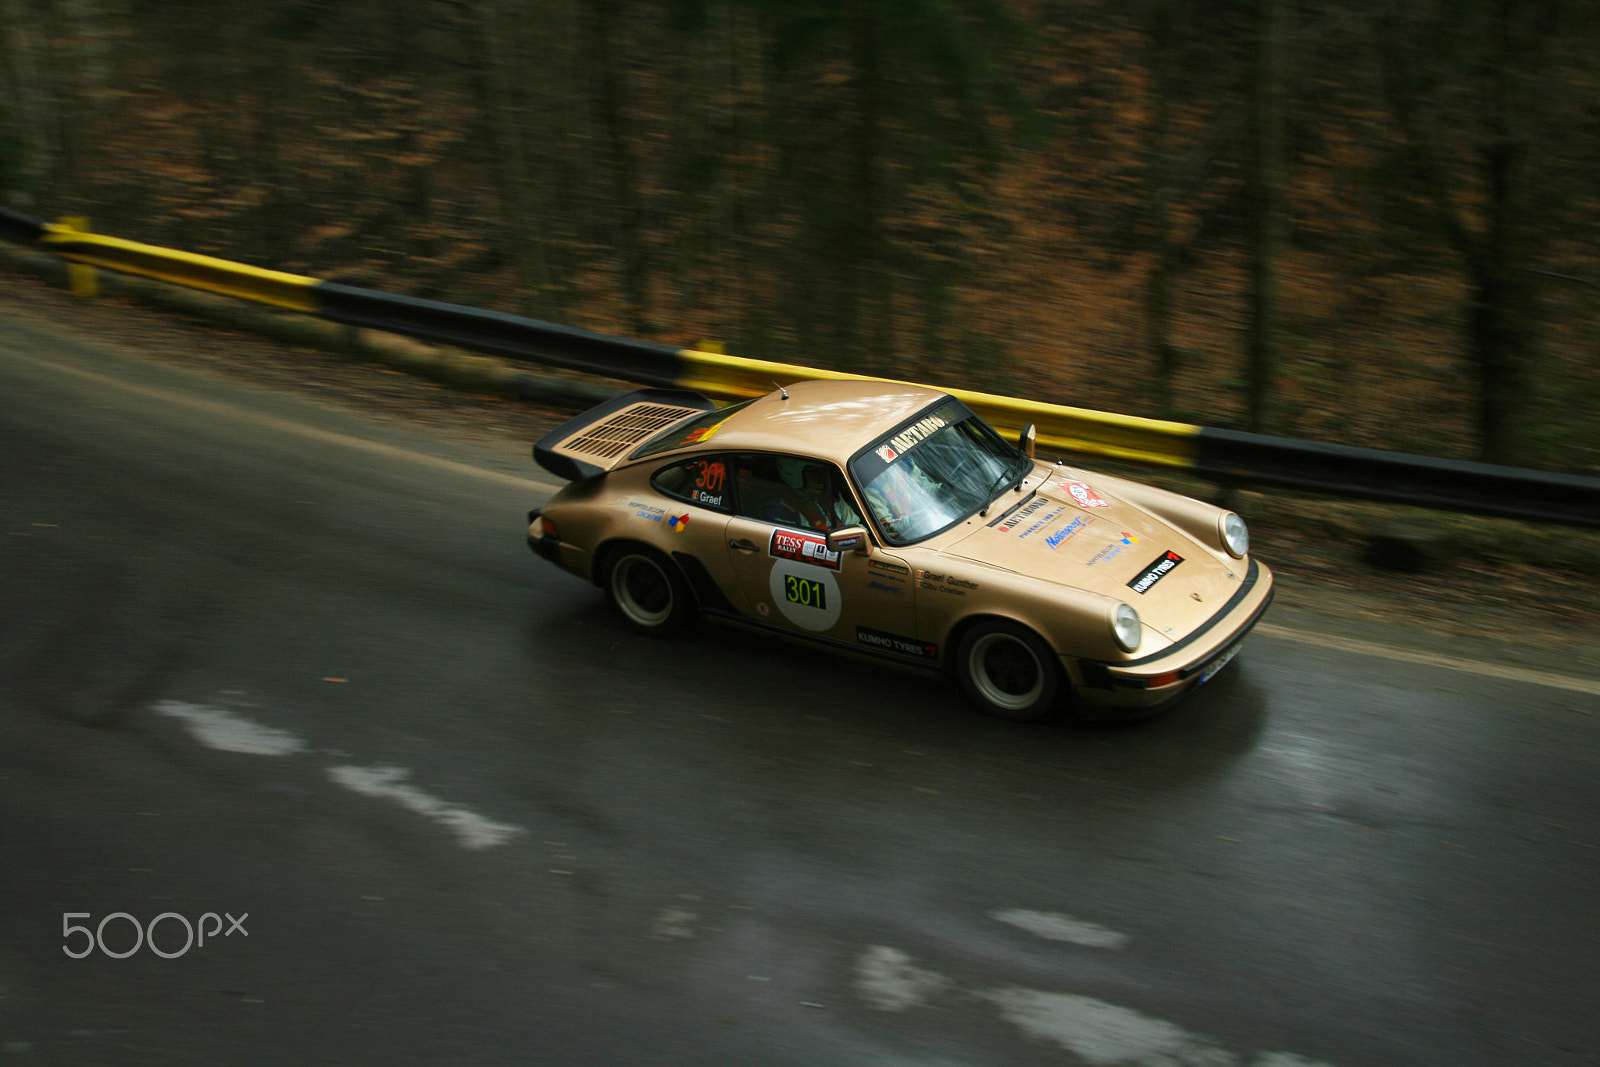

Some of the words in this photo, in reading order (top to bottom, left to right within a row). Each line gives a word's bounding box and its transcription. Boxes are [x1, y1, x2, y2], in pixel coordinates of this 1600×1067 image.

[696, 460, 725, 491] 301
[700, 491, 722, 505] Graef
[777, 535, 802, 548] TESS
[777, 545, 798, 553] RALLY
[1132, 573, 1159, 593] KUMHO
[1152, 559, 1175, 576] TYRES
[787, 576, 820, 608] 301
[857, 632, 892, 648] KUMHO
[893, 640, 923, 655] TYRES
